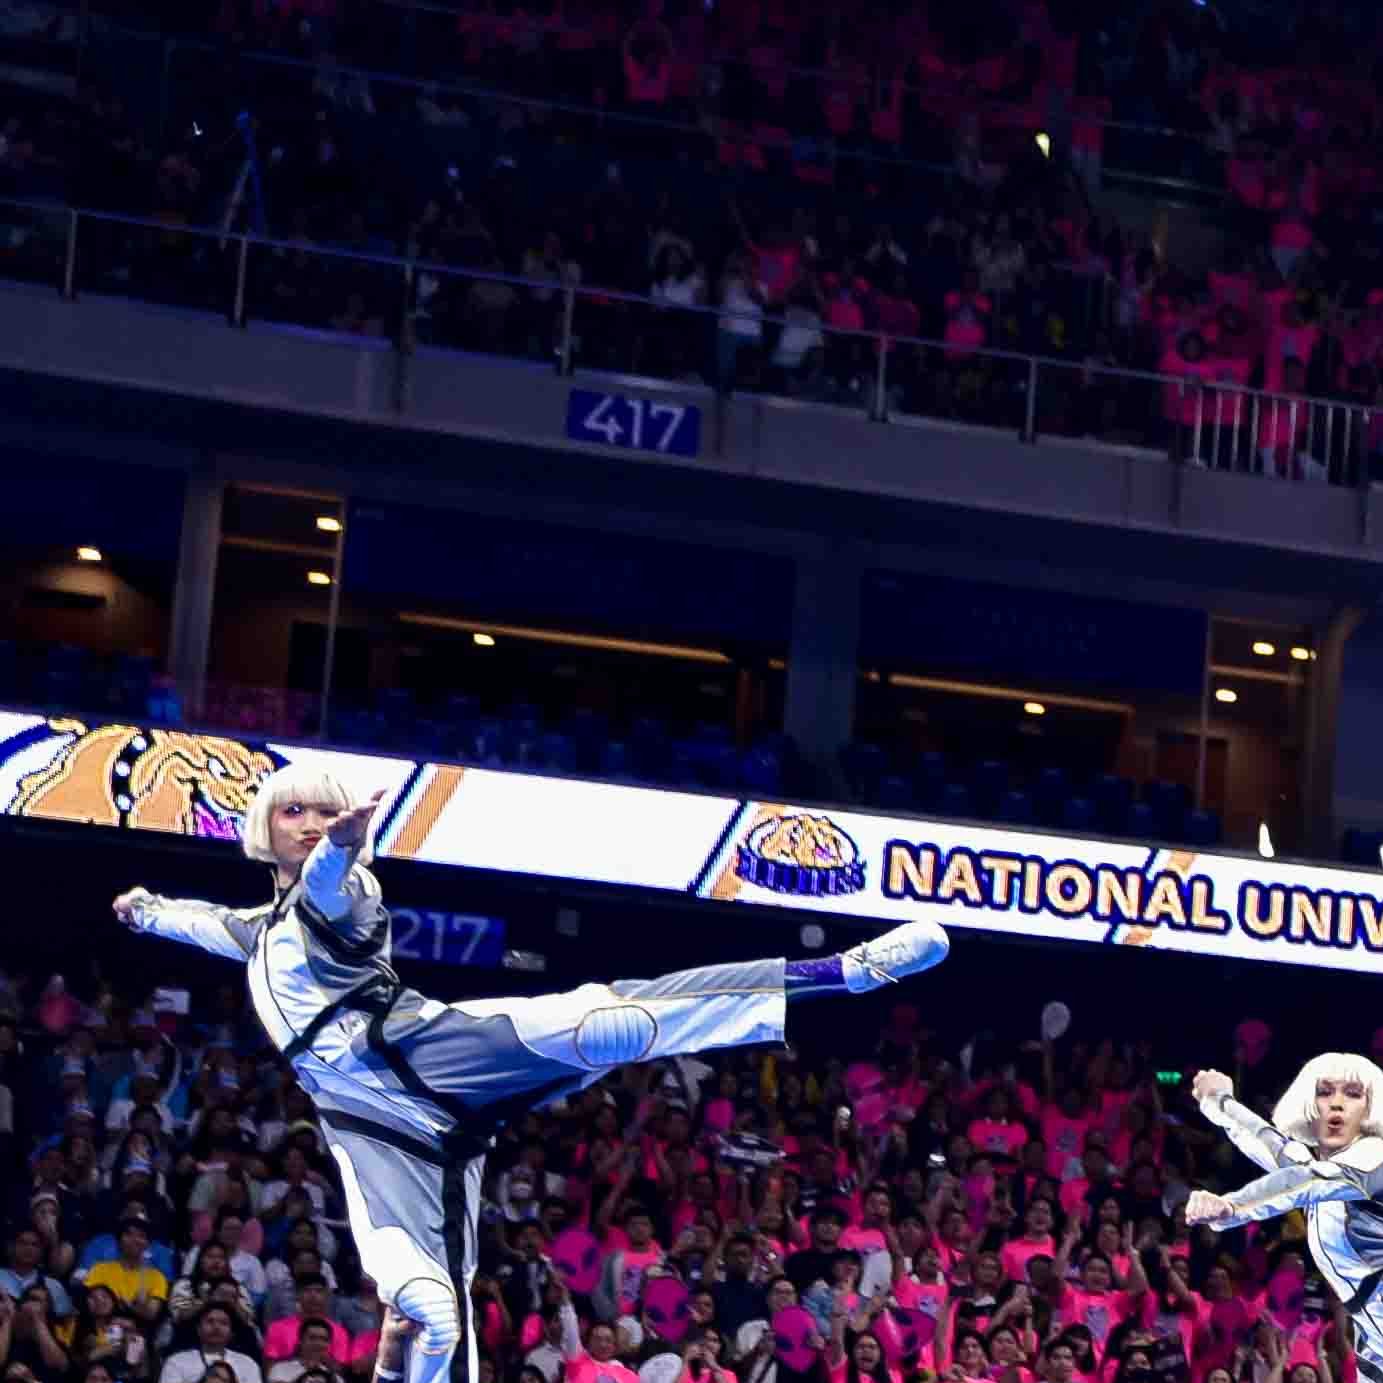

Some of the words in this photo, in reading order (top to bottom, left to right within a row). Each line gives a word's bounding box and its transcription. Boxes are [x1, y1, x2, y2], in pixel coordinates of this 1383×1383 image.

[582, 393, 686, 452] 417
[885, 841, 1229, 932] NATIONAL
[390, 907, 490, 965] 217
